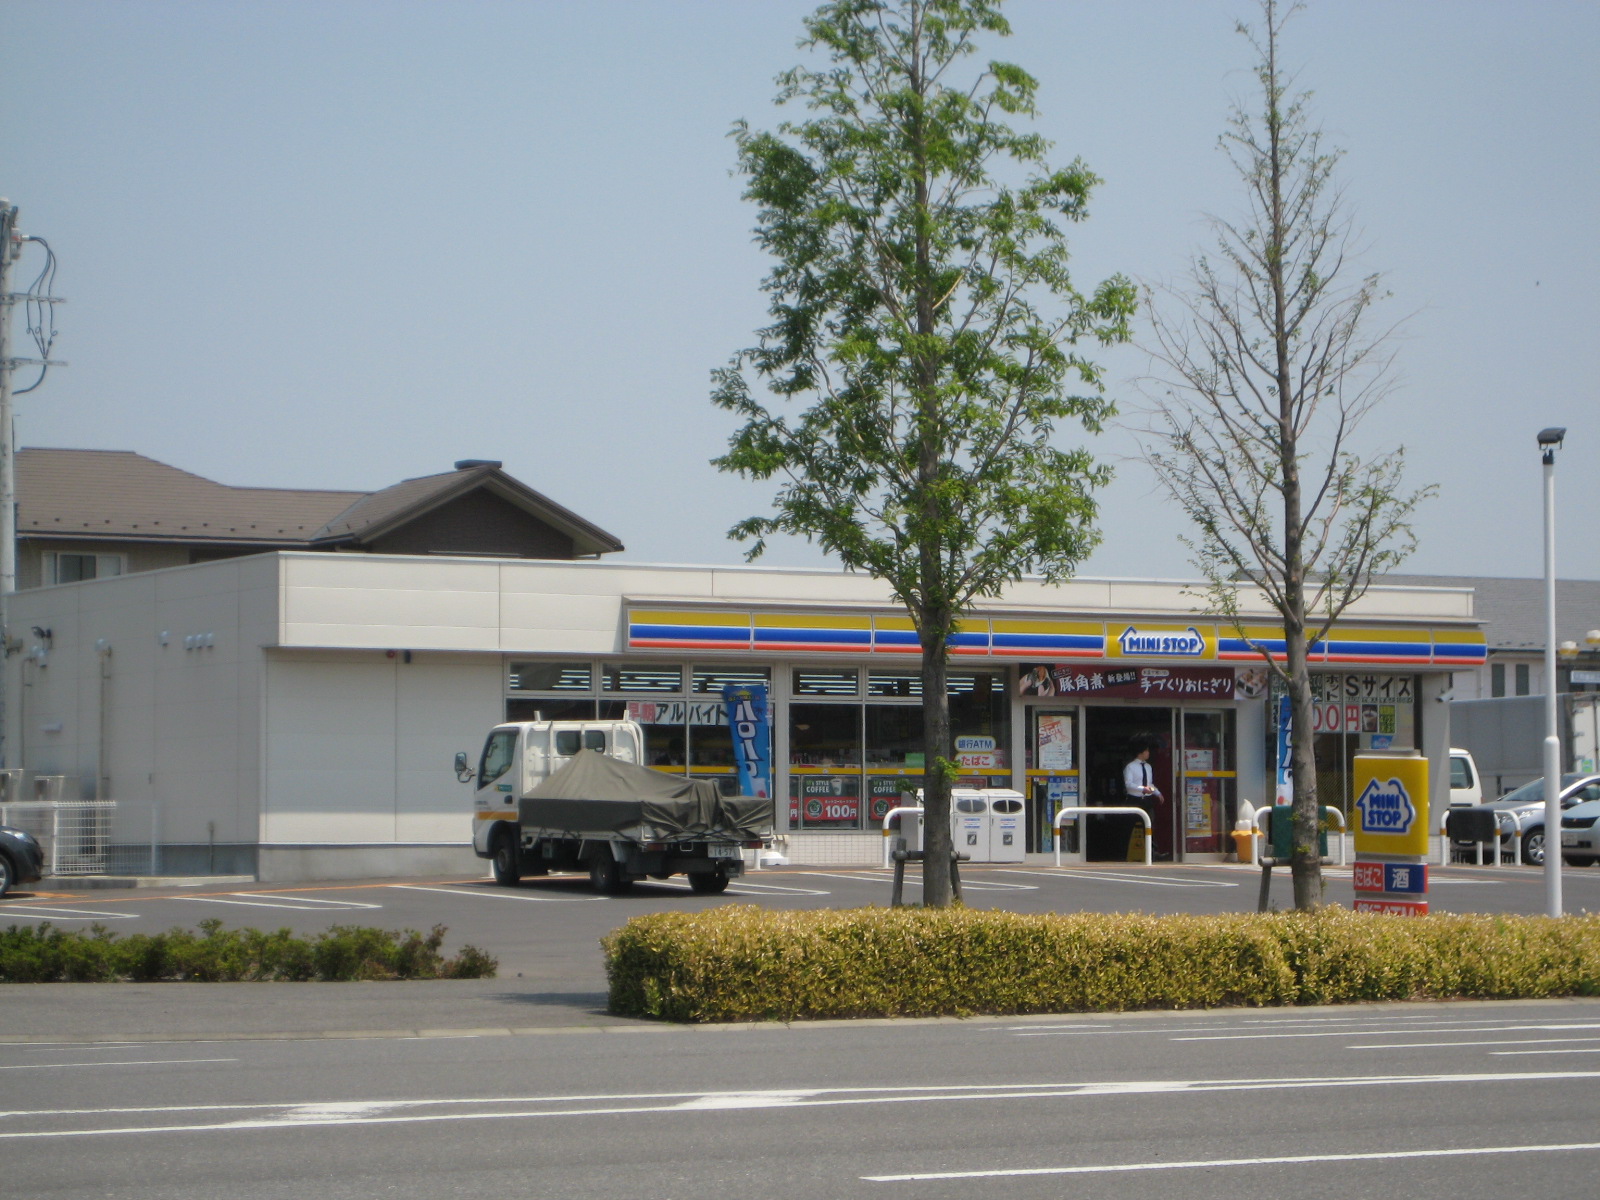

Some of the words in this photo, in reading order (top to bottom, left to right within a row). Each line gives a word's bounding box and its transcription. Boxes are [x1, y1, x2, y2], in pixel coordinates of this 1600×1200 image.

[1059, 672, 1105, 692] 豚角煮
[1140, 677, 1232, 694] 手づくりおにぎり
[1326, 675, 1338, 700] ホット
[1345, 675, 1411, 697] Sサイズ
[958, 739, 993, 749] 銀行ATM
[961, 756, 990, 766] たばこ
[1369, 793, 1400, 809] MINI
[825, 805, 857, 818] 100円
[1368, 810, 1402, 826] STOP
[1354, 867, 1382, 888] たばこ
[1392, 868, 1410, 889] 酒
